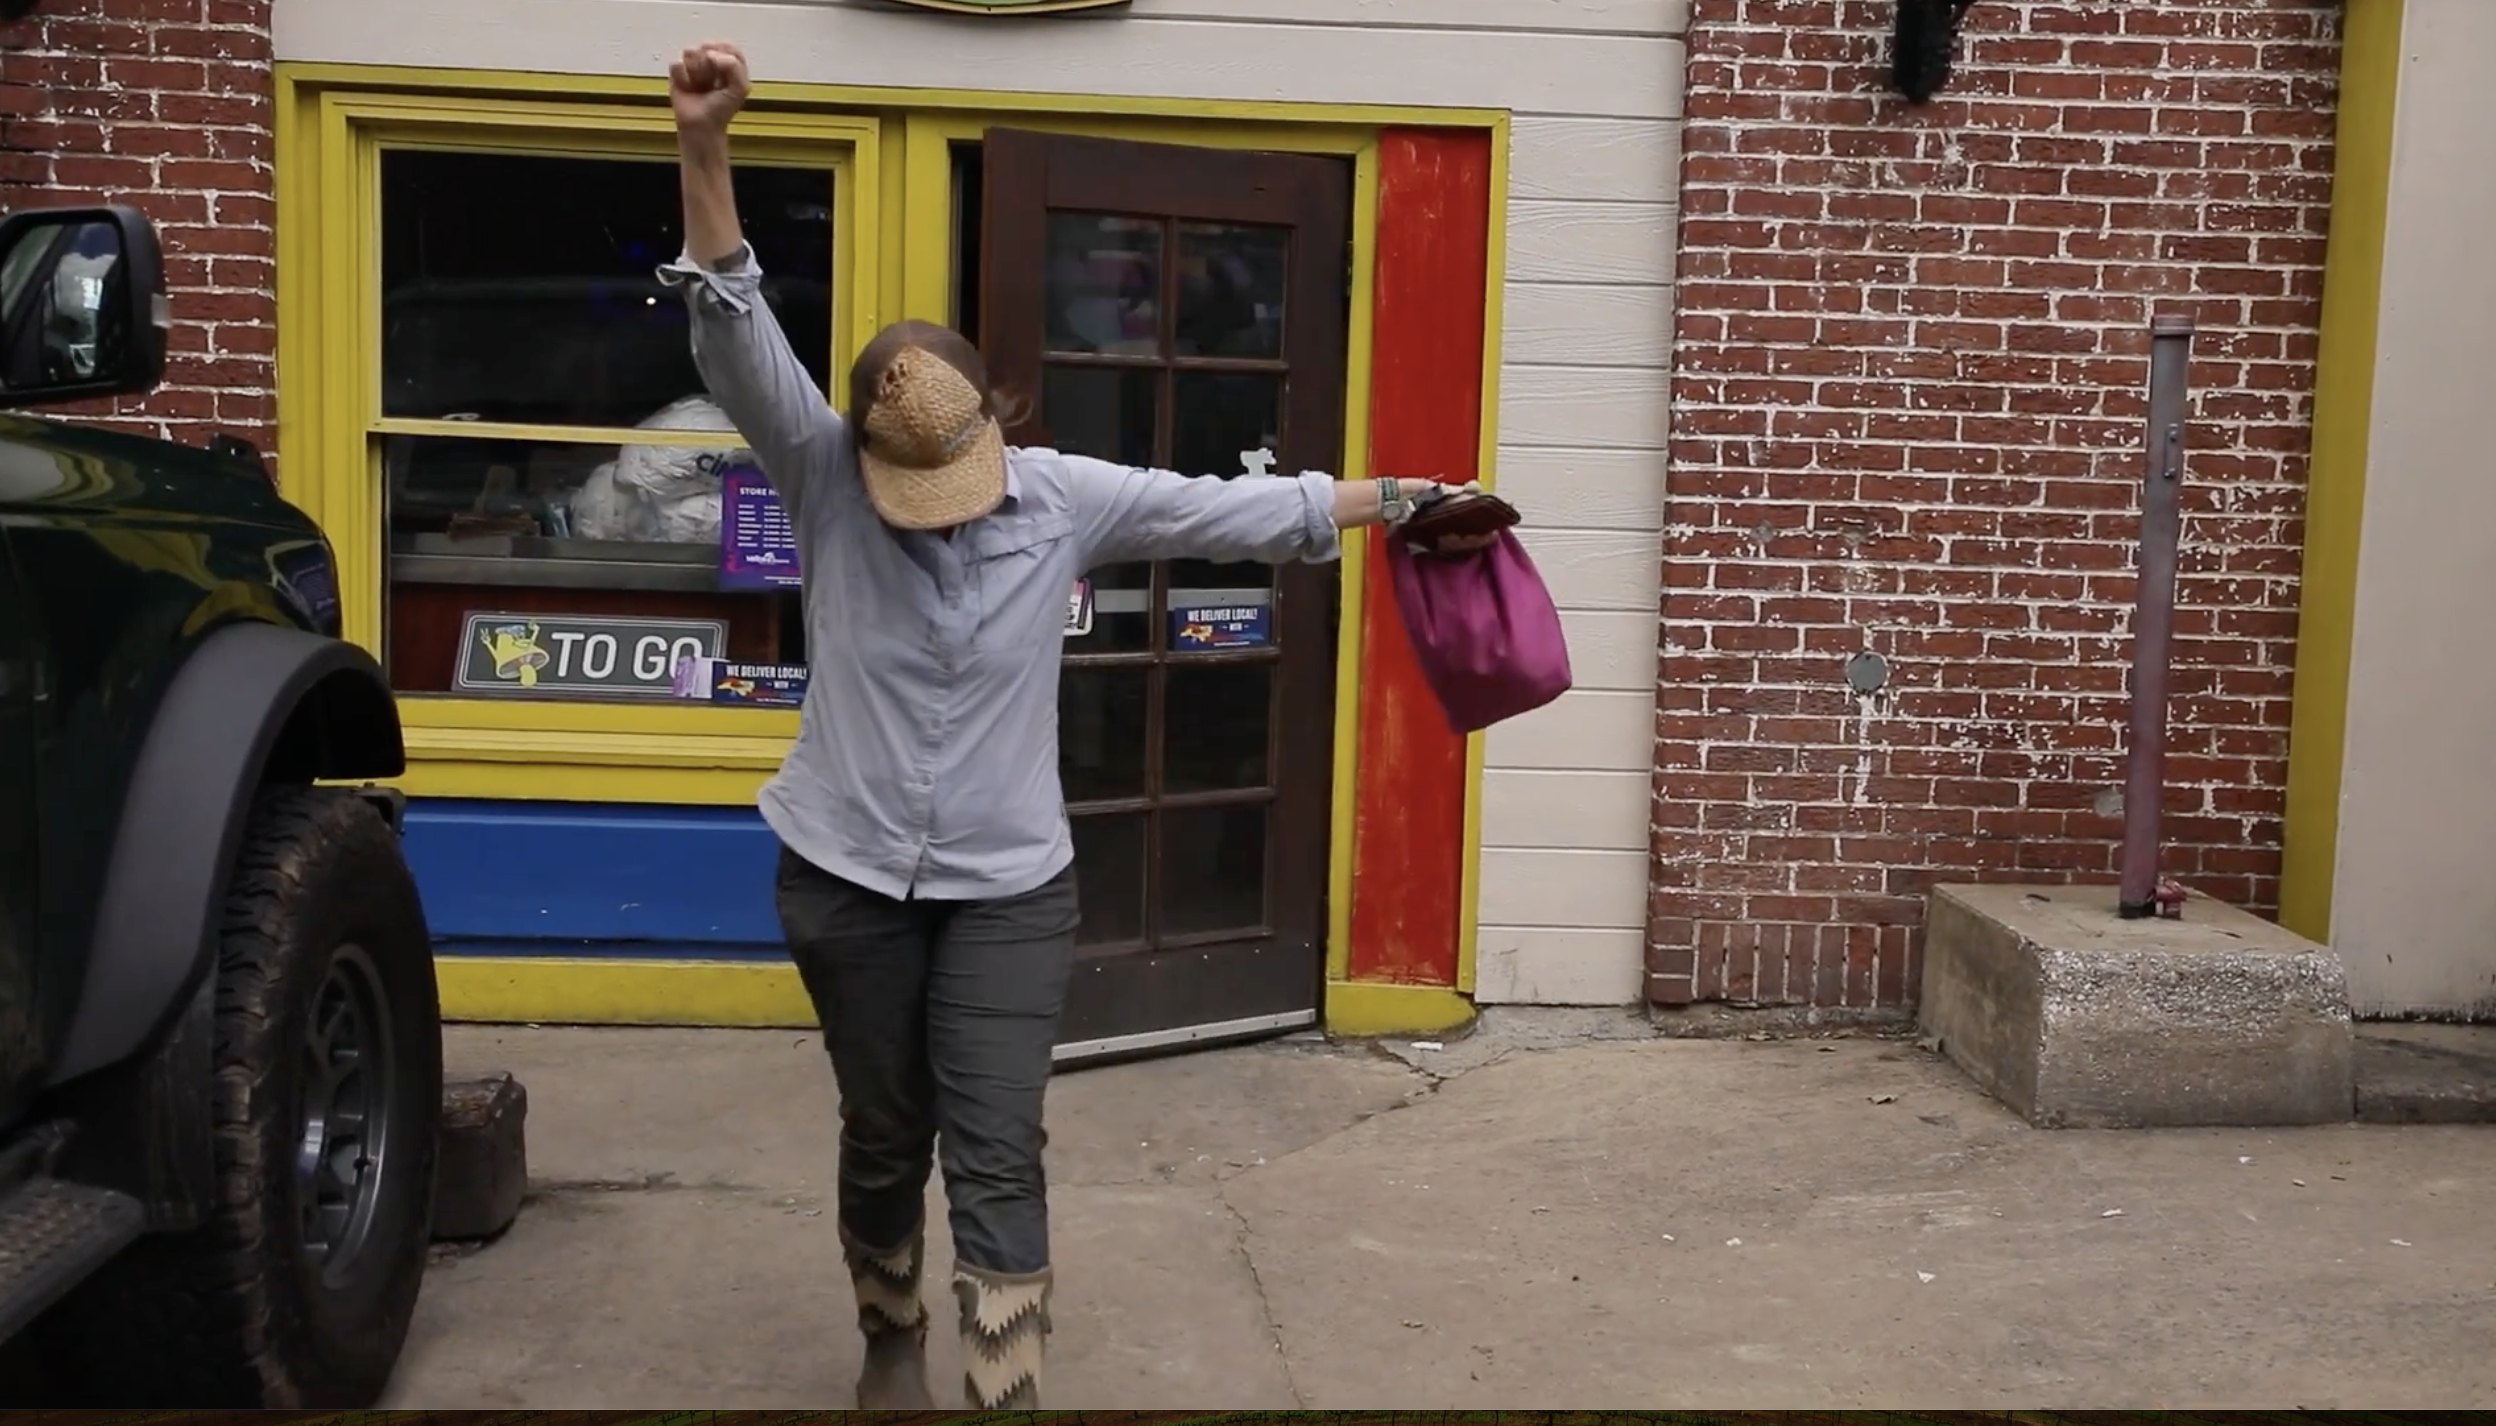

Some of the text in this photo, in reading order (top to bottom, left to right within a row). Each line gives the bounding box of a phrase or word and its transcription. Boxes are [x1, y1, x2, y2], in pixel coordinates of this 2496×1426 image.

[740, 487, 767, 496] STORE
[1187, 607, 1258, 621] WE DELIVER LOCAL!
[551, 632, 703, 680] TO GO
[726, 664, 807, 679] WE DELIVER LOCAL!
